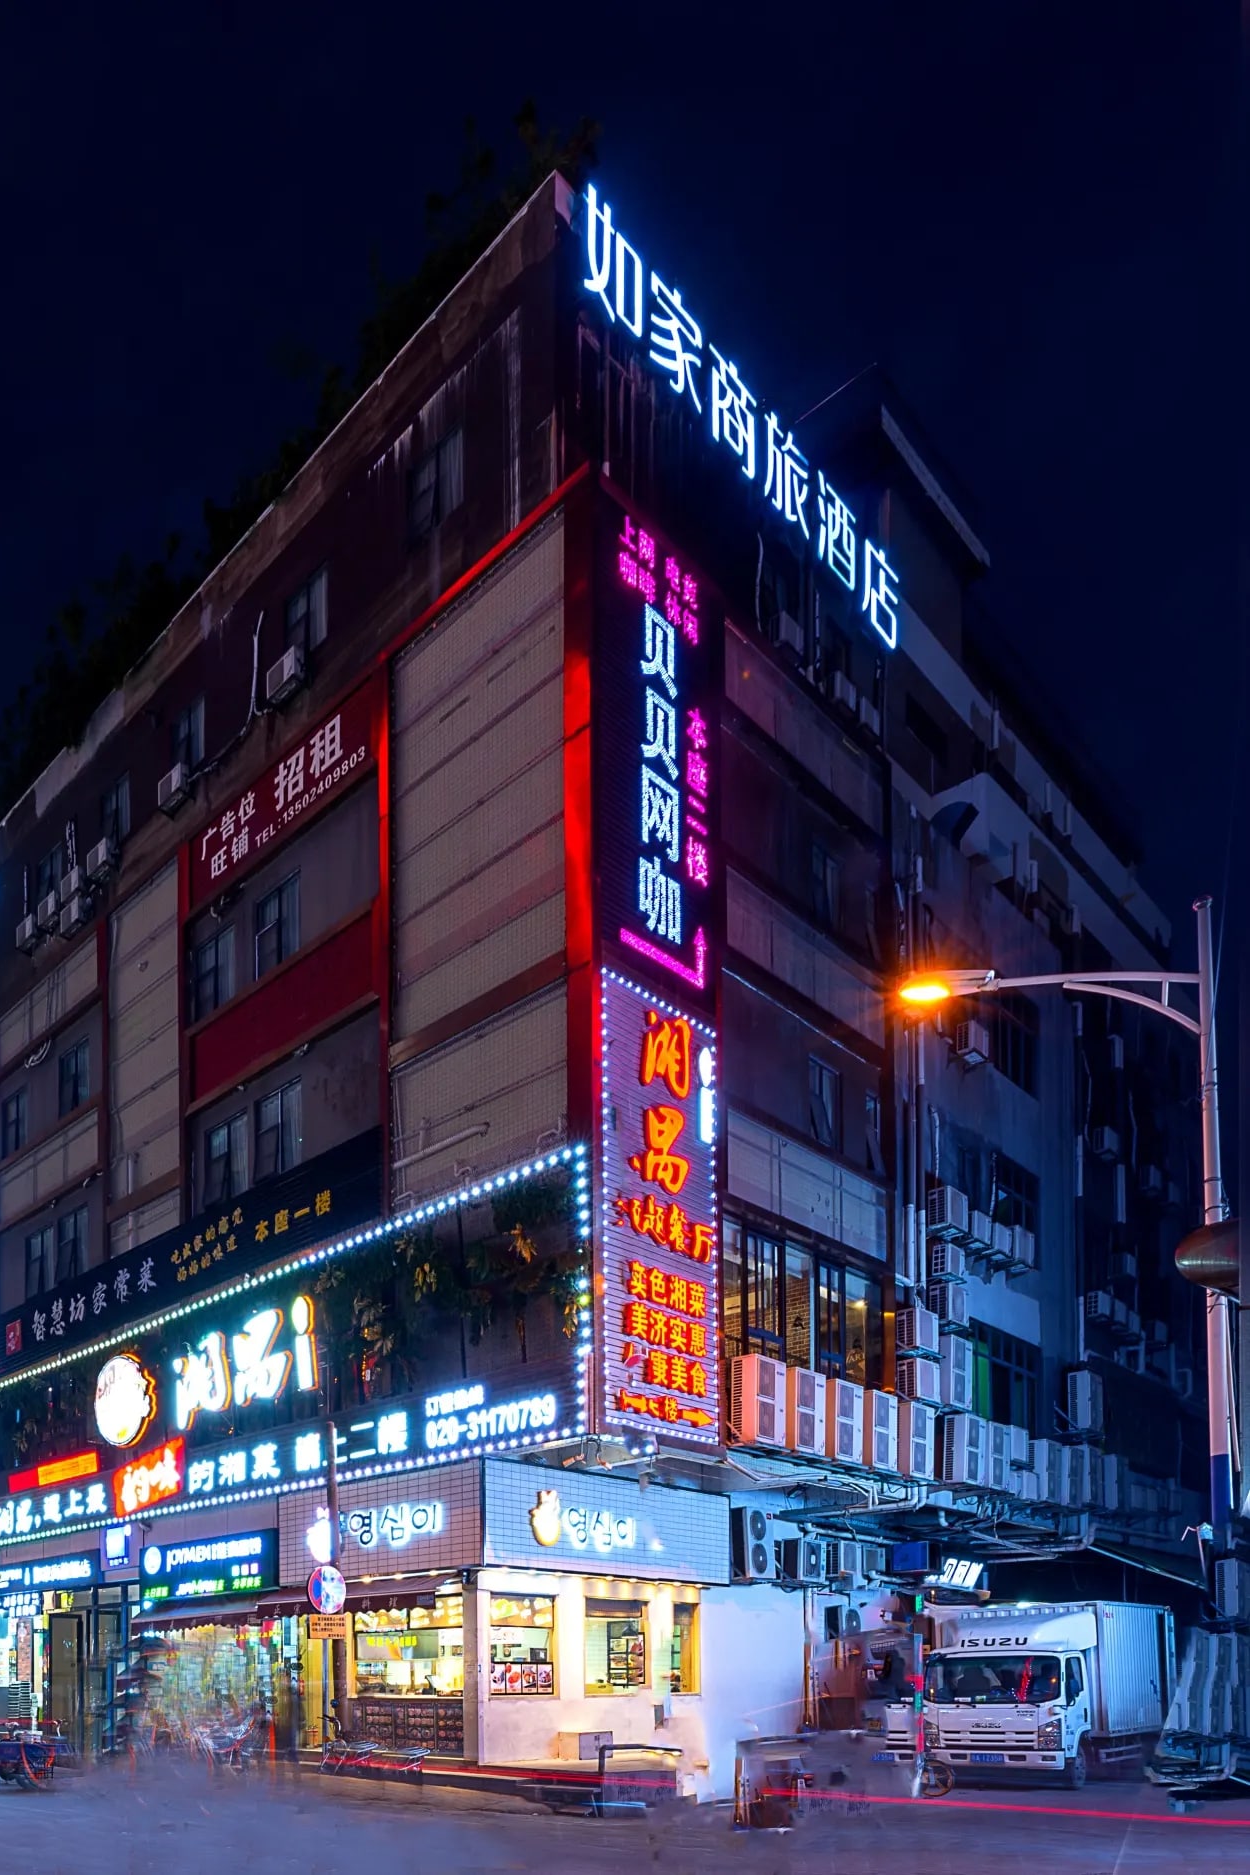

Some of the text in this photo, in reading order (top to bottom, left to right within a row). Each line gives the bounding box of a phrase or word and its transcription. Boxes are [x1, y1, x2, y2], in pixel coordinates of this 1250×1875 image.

[584, 183, 900, 650] 如家商旅酒店
[619, 515, 655, 569] 上网
[619, 551, 656, 604] 咖啡
[273, 714, 343, 812] 招租
[638, 602, 682, 945] 贝贝网咖
[686, 708, 708, 887] 本座二楼
[201, 791, 256, 861] 广告位
[210, 826, 249, 879] 旺铺
[254, 1190, 331, 1243] 本座一楼
[32, 1257, 157, 1341] 智慧坊家常菜
[425, 1394, 556, 1449] 020-31170789
[959, 1636, 1029, 1648] ISUZU
[971, 1719, 1002, 1728] ISUZU
